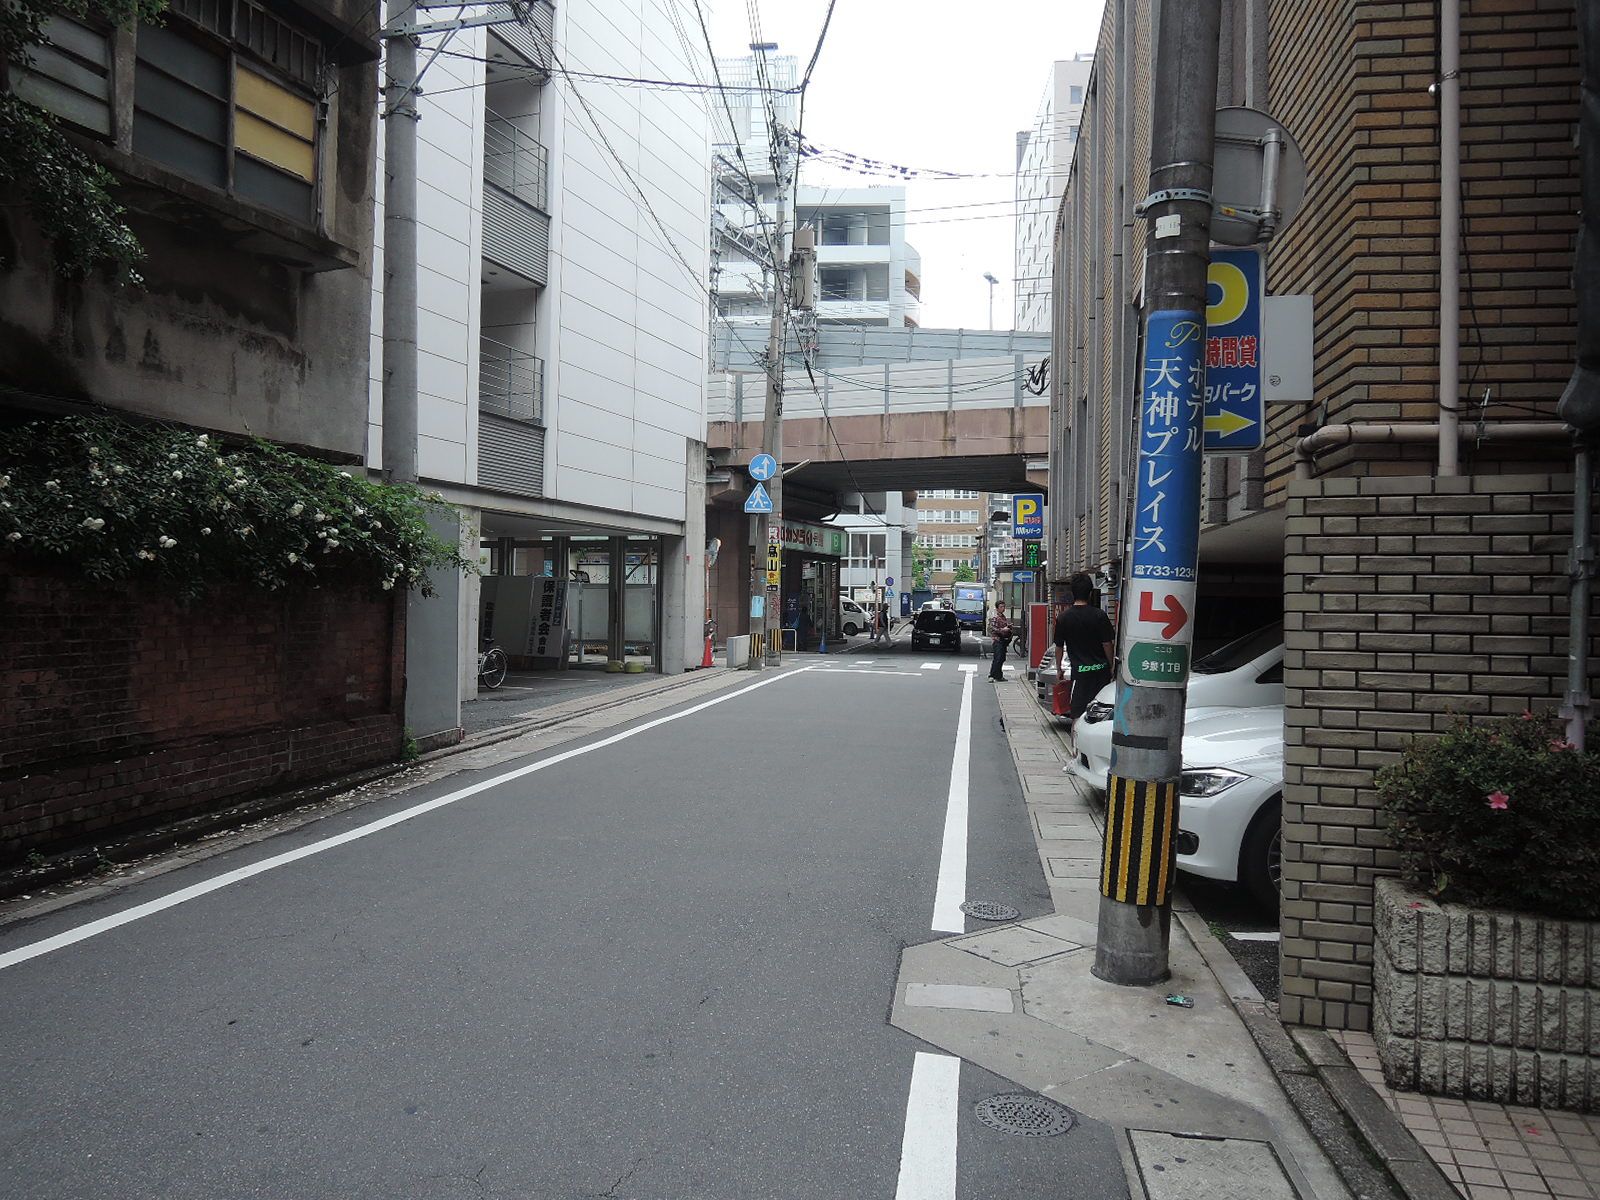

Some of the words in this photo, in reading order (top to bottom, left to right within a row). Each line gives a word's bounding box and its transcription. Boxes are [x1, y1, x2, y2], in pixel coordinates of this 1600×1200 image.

[1205, 335, 1257, 368] 時間貸
[1182, 358, 1205, 453] ホテル
[1136, 355, 1184, 554] 天神プレイス
[1016, 499, 1037, 525] P
[1145, 564, 1195, 578] 733-1234
[1153, 646, 1173, 654] ここは
